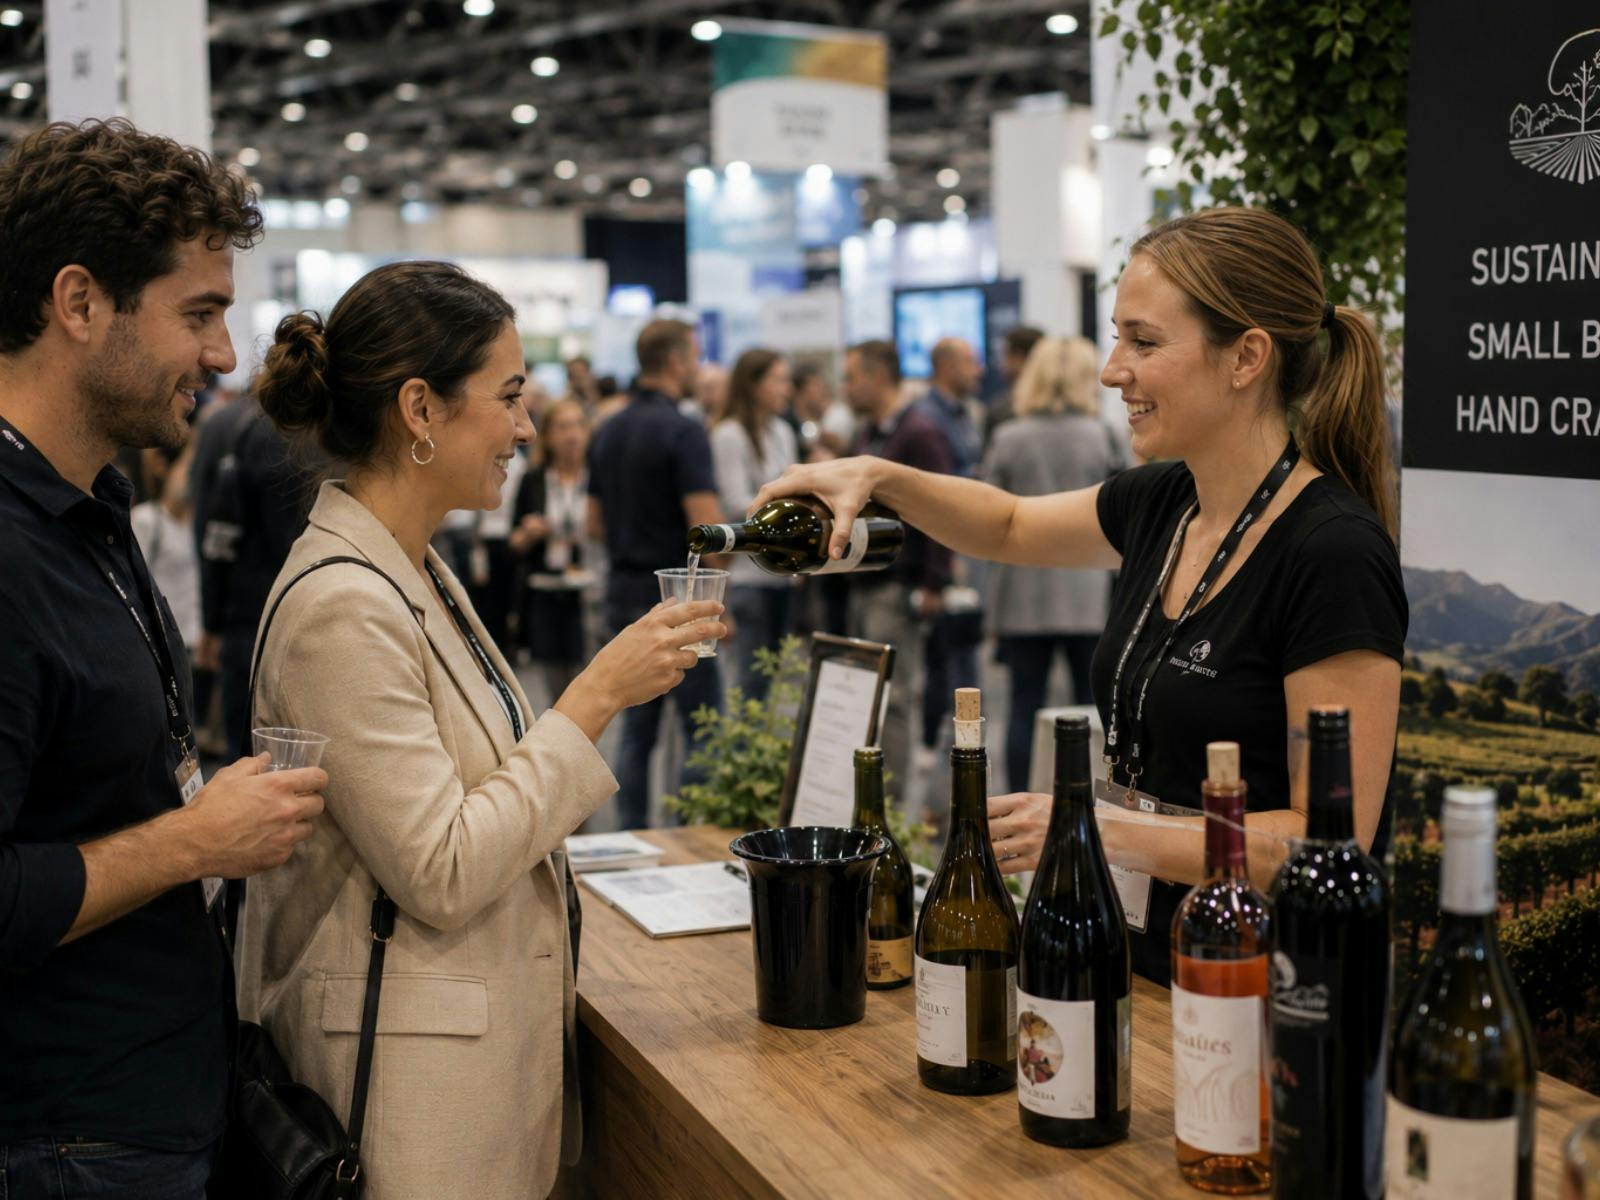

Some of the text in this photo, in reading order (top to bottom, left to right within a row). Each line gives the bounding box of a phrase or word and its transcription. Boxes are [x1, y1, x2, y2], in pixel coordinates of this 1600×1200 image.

[1471, 240, 1600, 286] SUSTAIN
[1467, 319, 1600, 360] SMALL B
[1456, 394, 1540, 434] HAND
